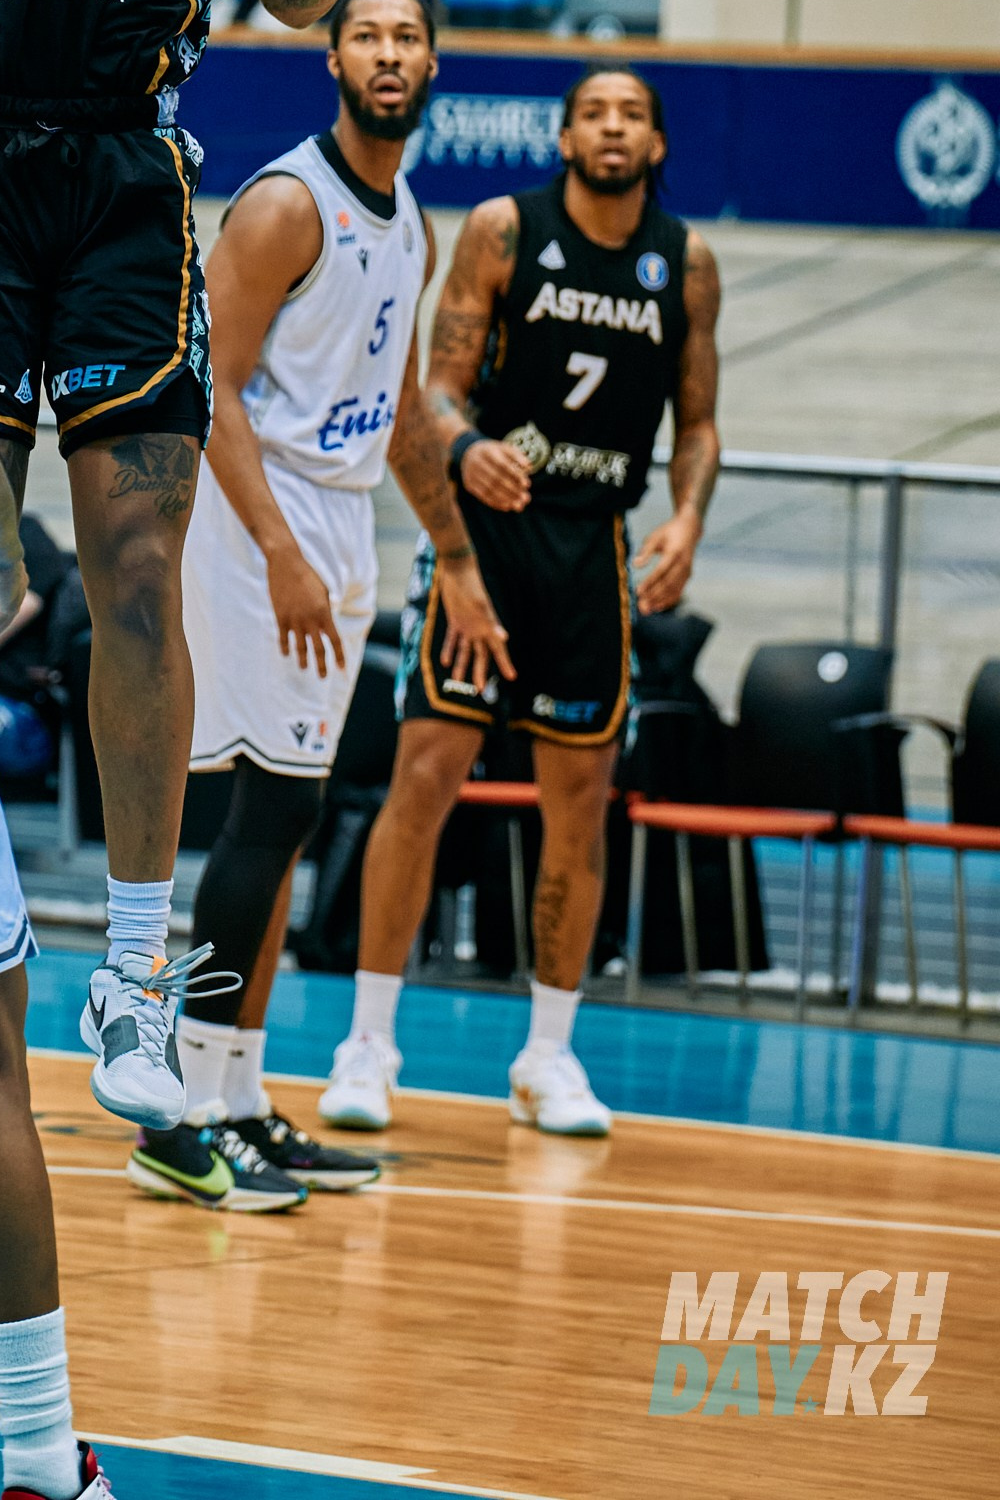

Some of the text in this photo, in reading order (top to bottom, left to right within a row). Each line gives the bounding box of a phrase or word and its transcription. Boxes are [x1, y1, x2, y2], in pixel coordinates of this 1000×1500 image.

[368, 297, 395, 356] 5
[525, 282, 662, 344] ASTANA
[562, 352, 608, 410] 7
